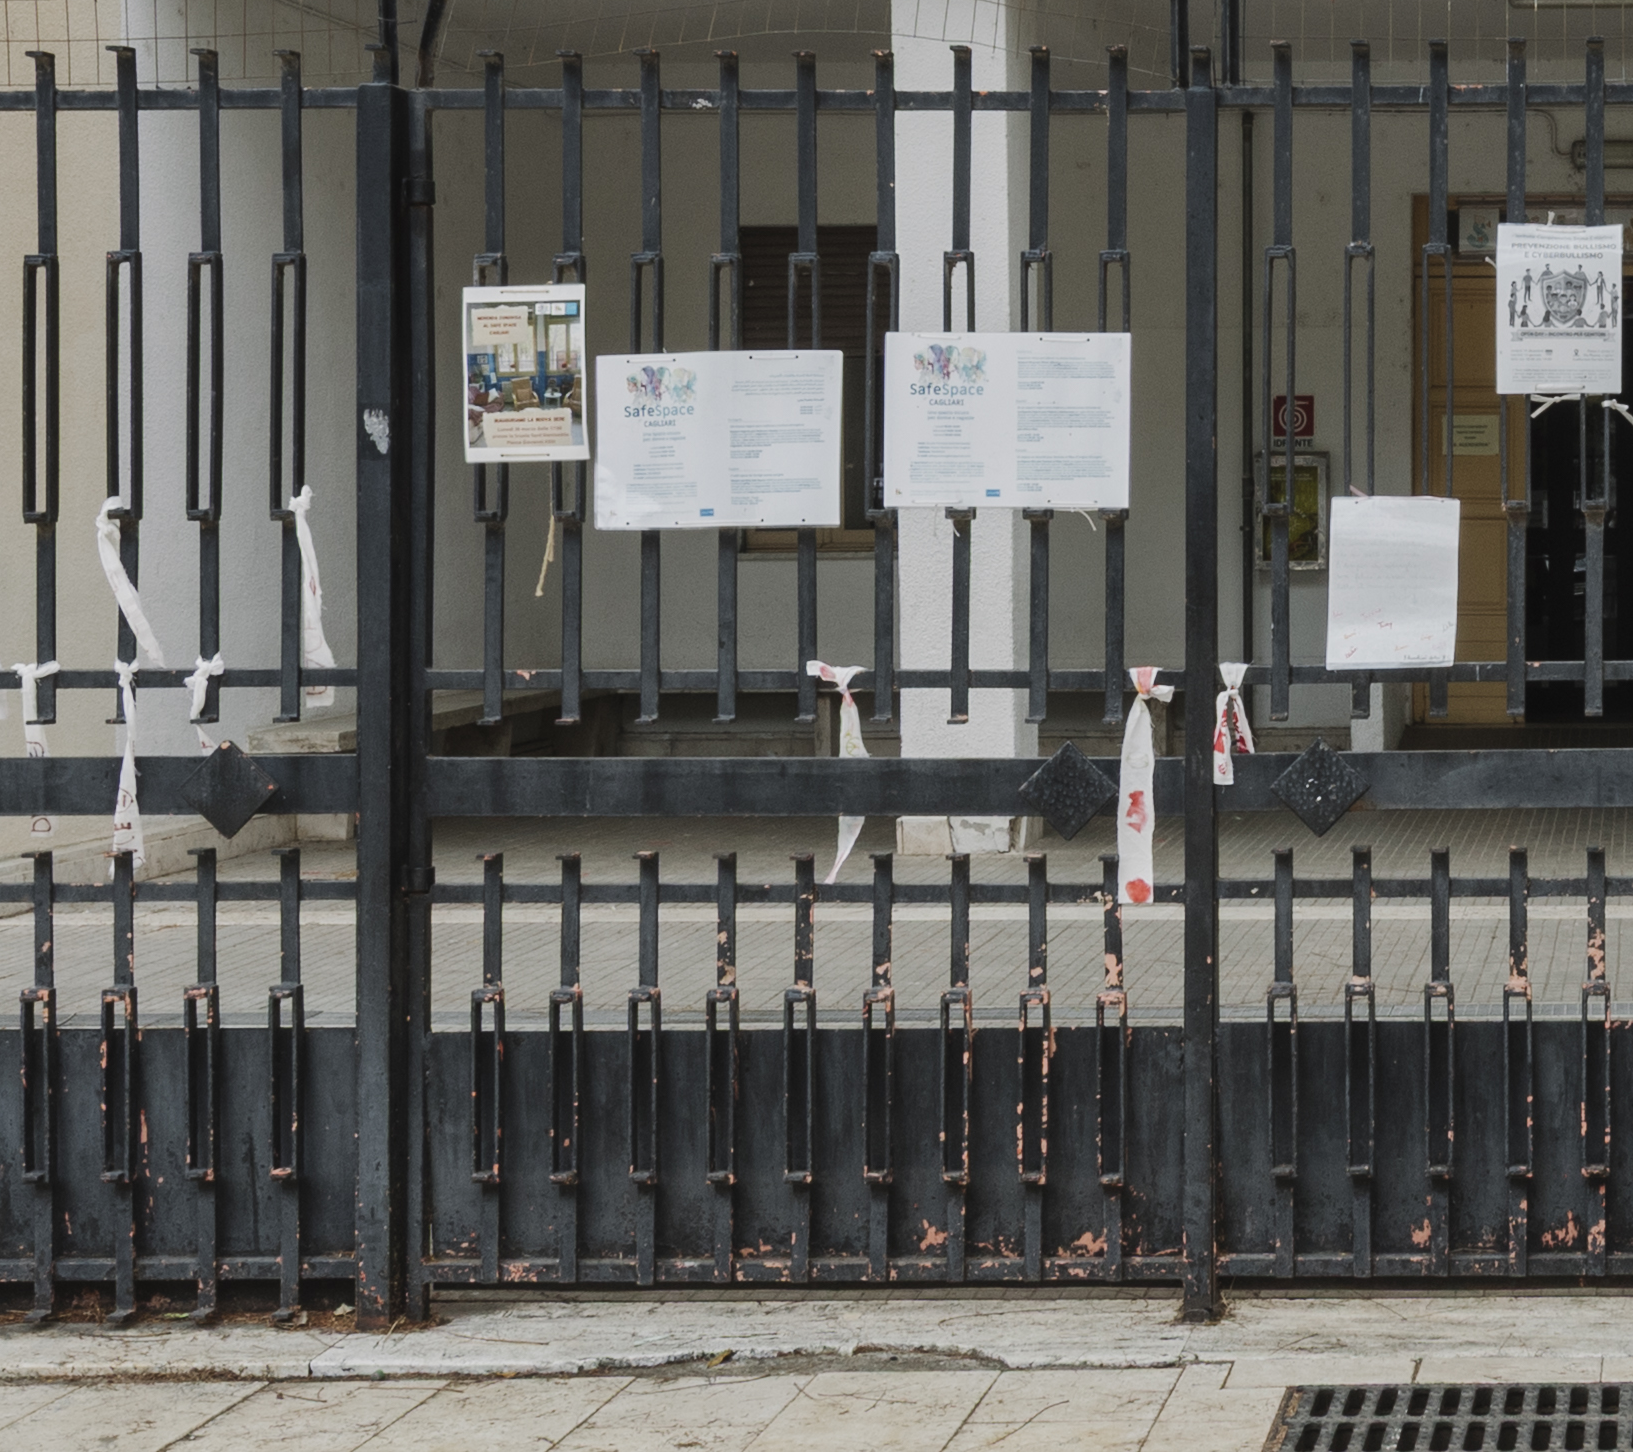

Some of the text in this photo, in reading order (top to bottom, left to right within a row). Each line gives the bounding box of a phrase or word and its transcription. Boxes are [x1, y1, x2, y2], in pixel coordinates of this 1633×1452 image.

[1511, 242, 1571, 250] PREVENZIONE
[910, 383, 984, 398] SafeSpace
[929, 398, 965, 406] CAGLIARI
[624, 404, 695, 419] SafeSpace
[643, 419, 677, 428] CAGLIARI
[1273, 438, 1314, 448] IDRNTE
